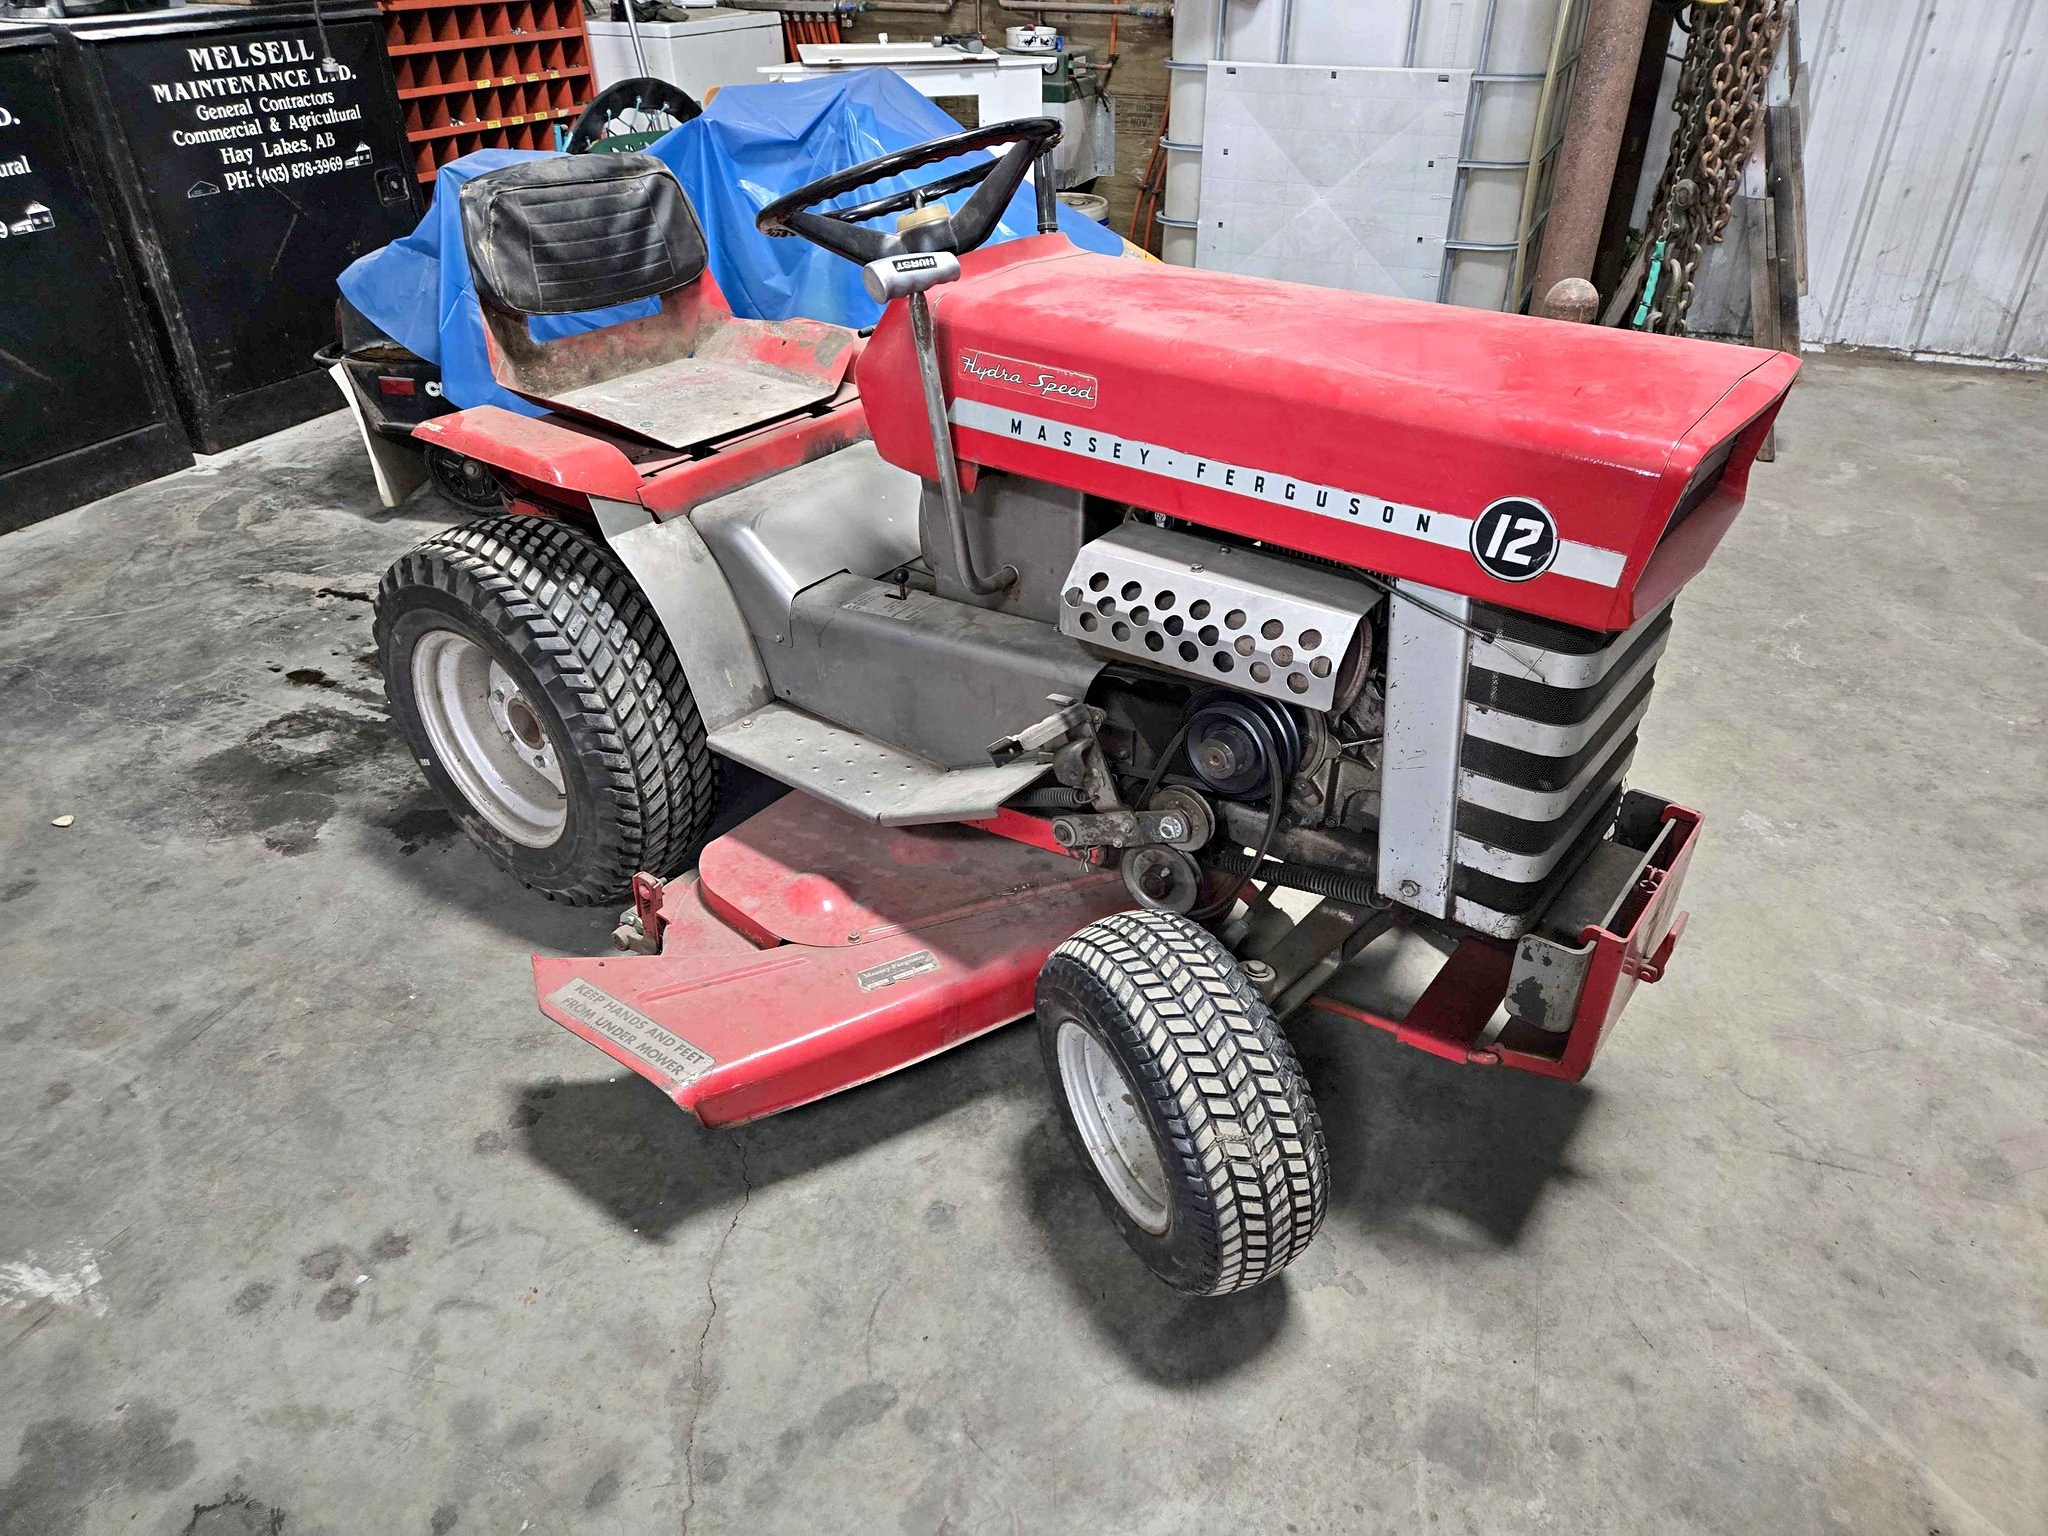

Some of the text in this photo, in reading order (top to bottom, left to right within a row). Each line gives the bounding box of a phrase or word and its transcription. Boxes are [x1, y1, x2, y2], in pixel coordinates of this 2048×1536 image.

[186, 39, 315, 72] MELSELL
[151, 64, 357, 104] MAINTENANCE LD.
[172, 104, 362, 146] Commercial & Agricultural
[196, 91, 335, 121] General Contractors
[220, 132, 336, 165] Hay Lakes, AB
[224, 156, 344, 191] PH: (403) 878-3969
[896, 257, 935, 271] HURST
[960, 352, 1096, 401] Hydra Speed
[1485, 512, 1545, 566] 12
[561, 997, 686, 1076] FROM UNDER MOWER
[574, 983, 705, 1065] KEEP HANDS AND FEET
